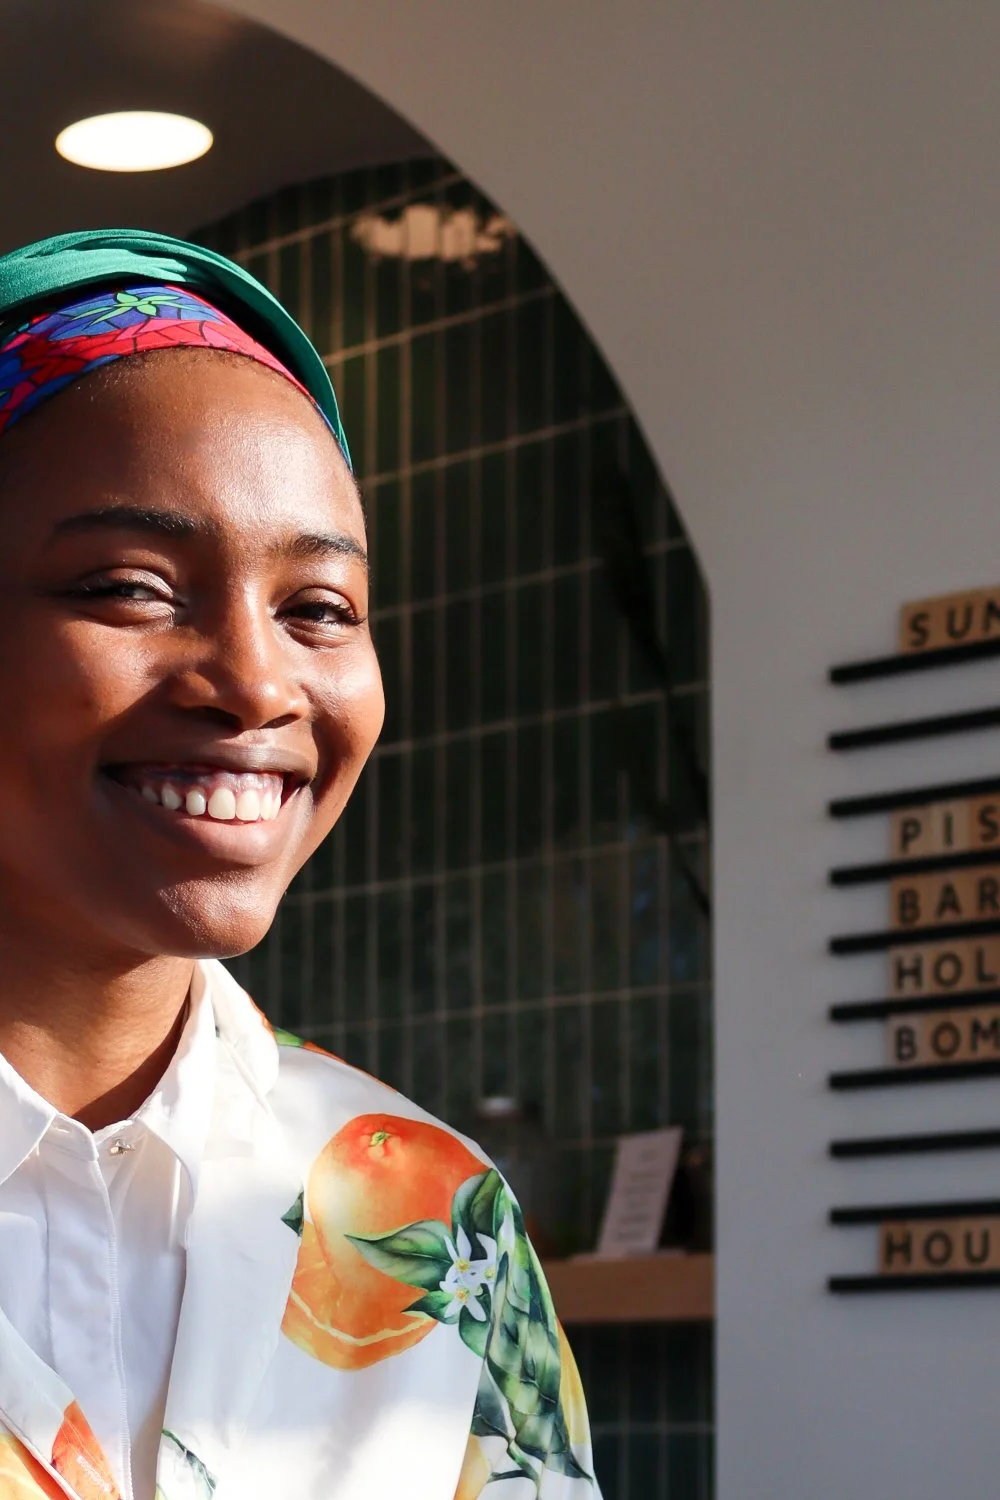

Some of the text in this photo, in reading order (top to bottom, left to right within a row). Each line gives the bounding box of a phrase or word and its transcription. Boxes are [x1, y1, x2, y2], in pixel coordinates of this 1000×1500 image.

[901, 804, 1000, 852] PIS
[899, 877, 1000, 923] BAR
[896, 947, 999, 991] HOL
[896, 1018, 1000, 1062] BOM
[885, 1227, 990, 1267] HOU
